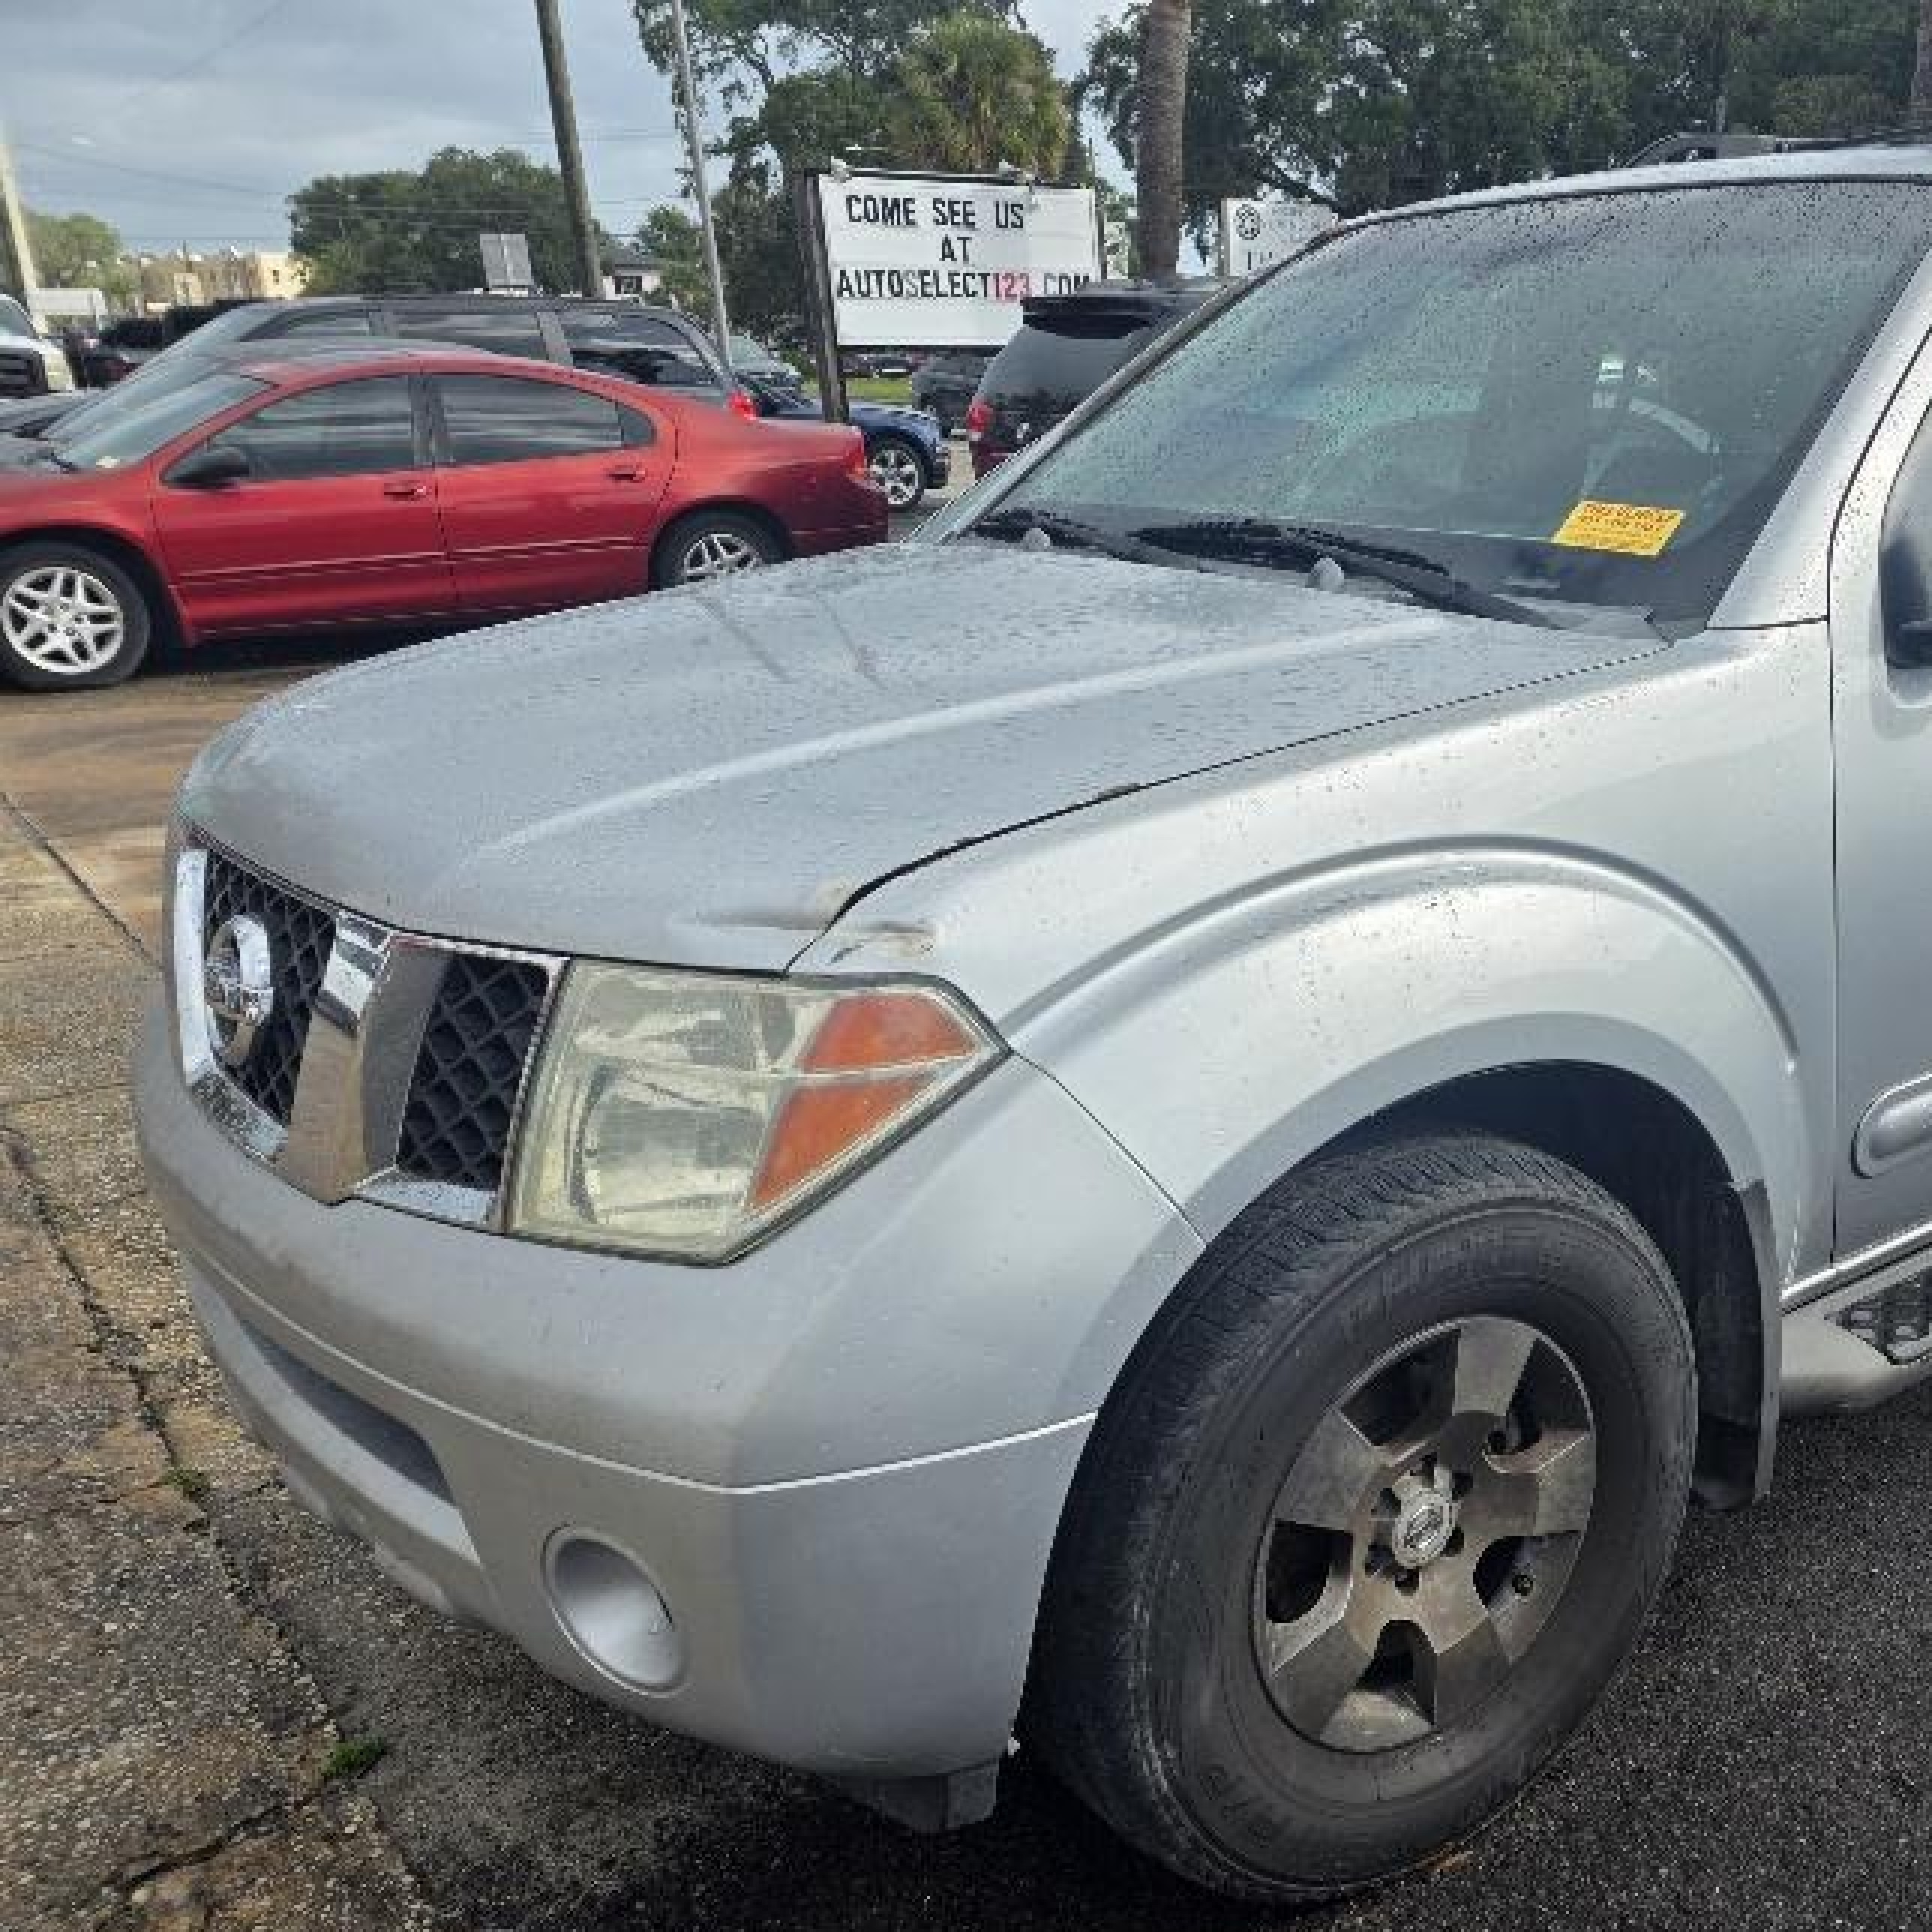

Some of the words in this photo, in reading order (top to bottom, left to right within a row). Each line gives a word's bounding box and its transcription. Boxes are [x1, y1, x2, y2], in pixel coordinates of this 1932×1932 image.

[845, 194, 916, 226] COME
[932, 197, 976, 226] SEE
[995, 200, 1024, 229] US
[939, 235, 972, 262] AT
